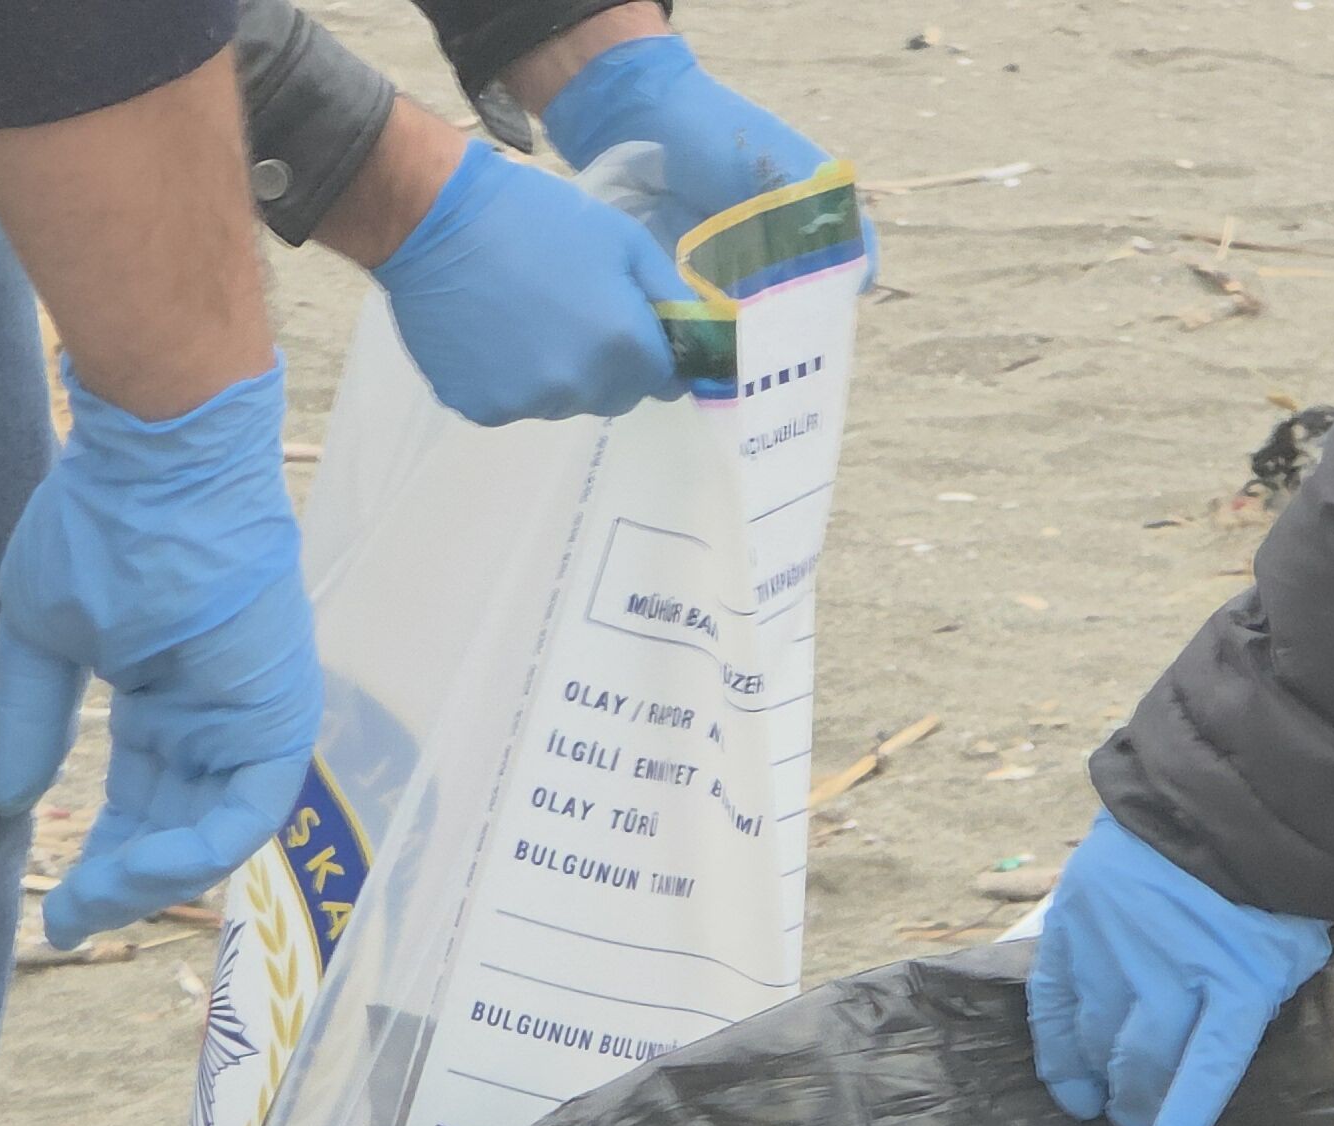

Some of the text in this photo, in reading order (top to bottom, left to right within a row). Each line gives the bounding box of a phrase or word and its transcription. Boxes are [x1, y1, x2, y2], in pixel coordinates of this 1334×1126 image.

[564, 680, 629, 716] OLAY
[546, 728, 622, 773] İLGİLİ
[531, 786, 659, 838] OLAY TÜRÜ
[514, 838, 641, 891] BULGUNUN
[470, 999, 594, 1052] BULGUNUN
